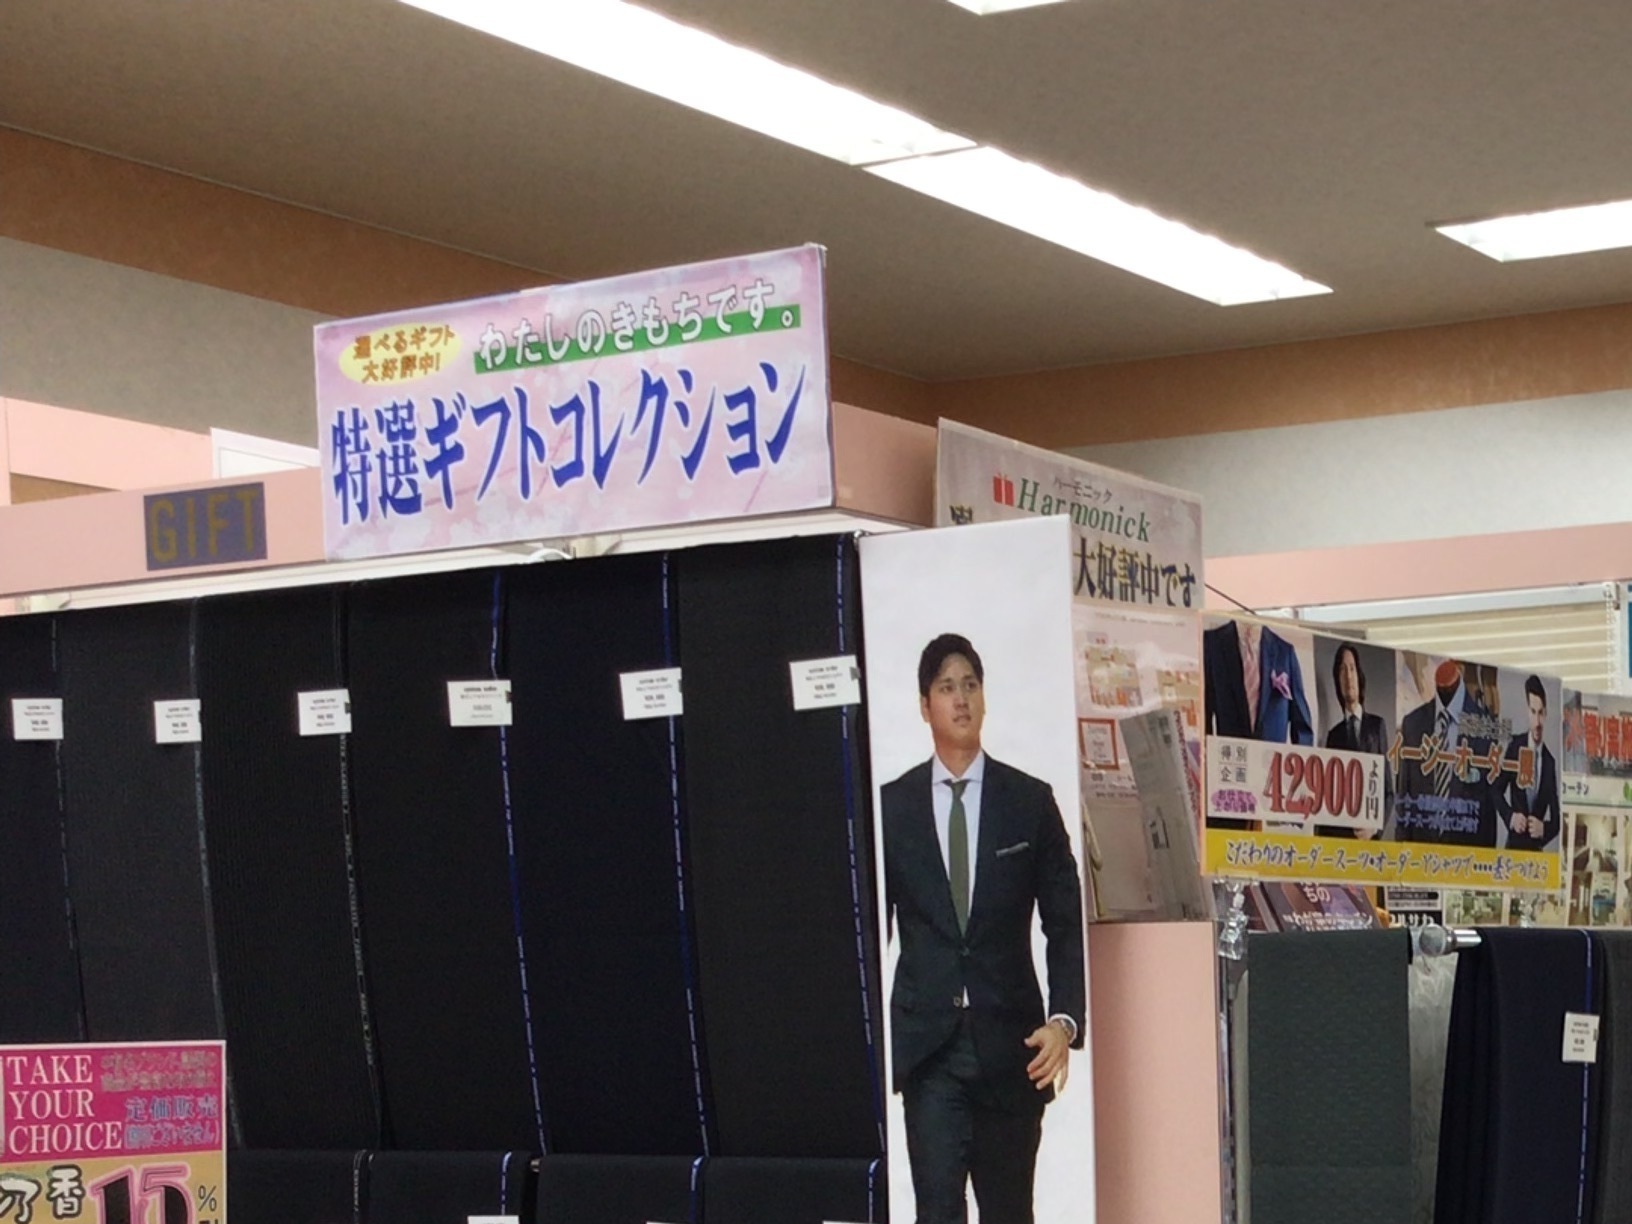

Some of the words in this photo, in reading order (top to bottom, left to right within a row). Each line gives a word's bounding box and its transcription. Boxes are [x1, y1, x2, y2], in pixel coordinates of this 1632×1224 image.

[353, 324, 455, 360] 選べるギフト
[332, 362, 806, 525] 特選ギフトコレクション
[152, 489, 259, 563] GIFT
[1017, 478, 1151, 542] Harmonick
[1073, 536, 1196, 608] 大好評中です
[6, 1054, 93, 1086] TAKE
[9, 1089, 95, 1120] YOUR
[9, 1121, 123, 1155] CHOICE
